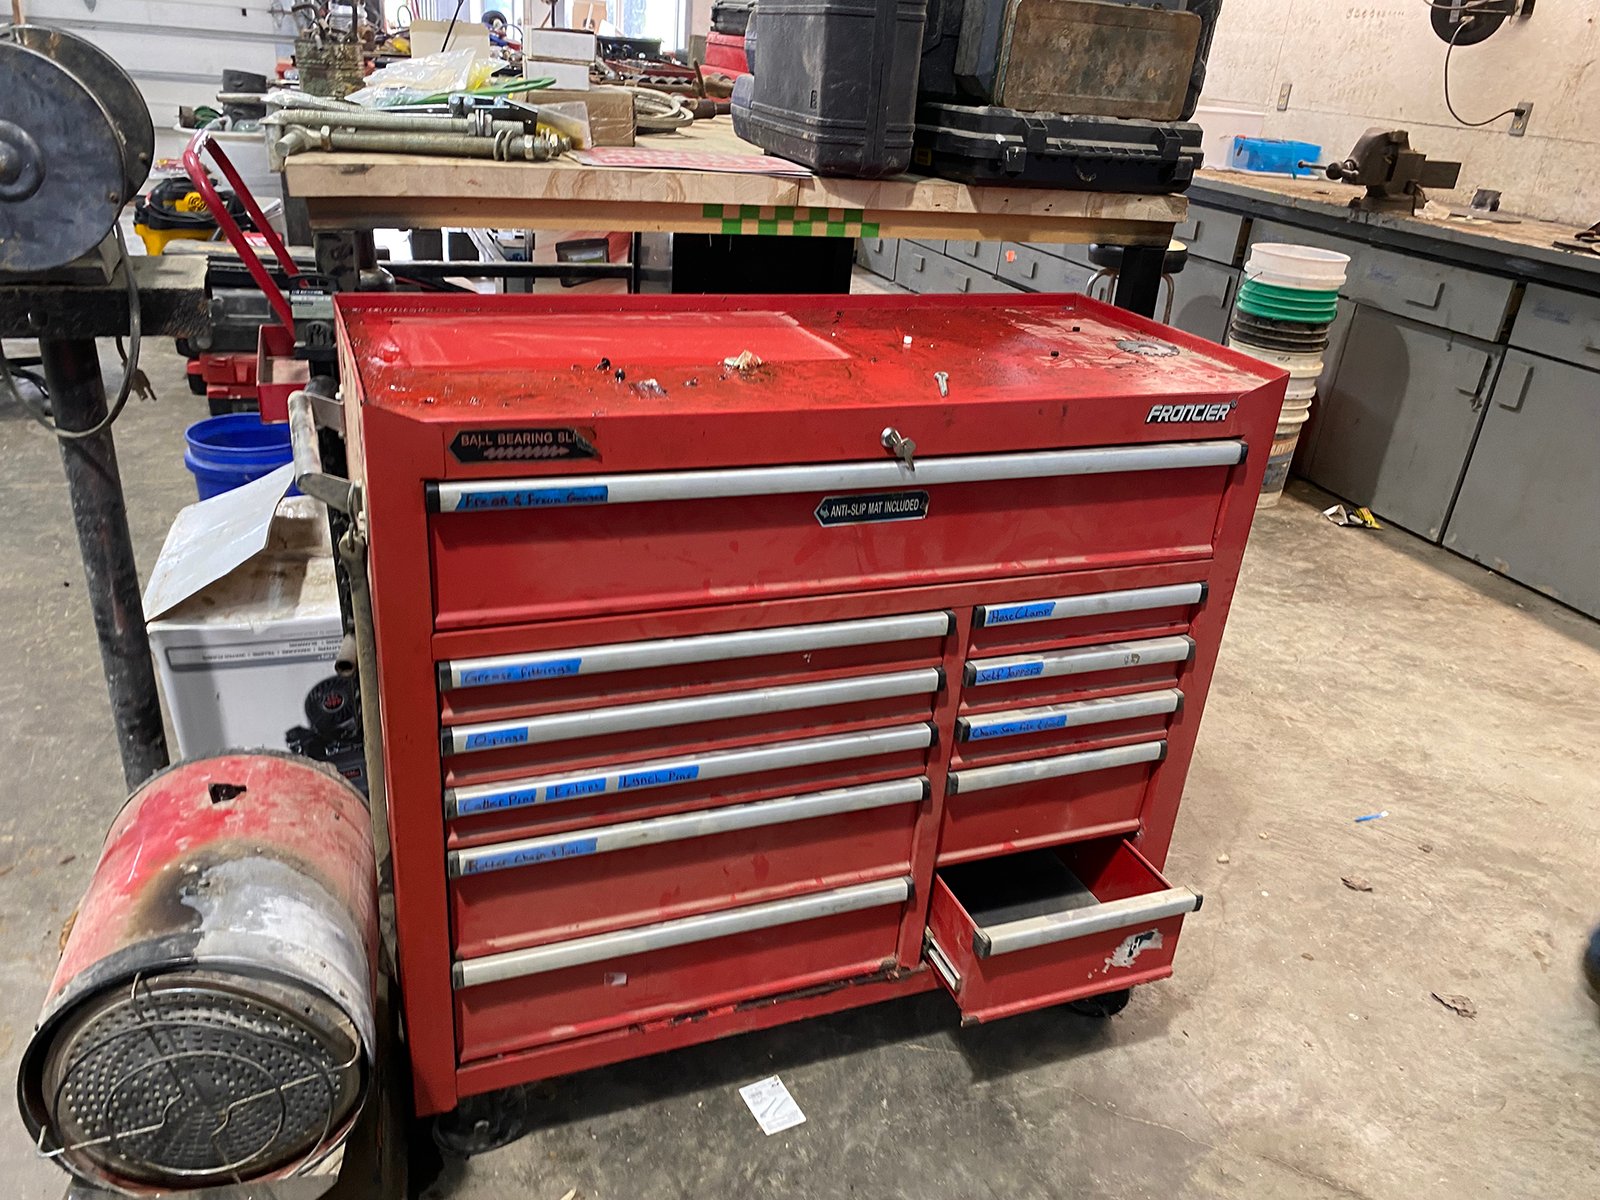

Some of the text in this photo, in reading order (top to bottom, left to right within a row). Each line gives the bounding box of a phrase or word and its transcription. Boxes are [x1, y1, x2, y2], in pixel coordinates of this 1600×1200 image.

[461, 434, 493, 448] BALL
[497, 431, 553, 445] BEARING
[830, 499, 919, 517] ANTI-SLIP MAT INCLUDED
[991, 609, 1015, 622] Hose
[979, 667, 1003, 681] Self
